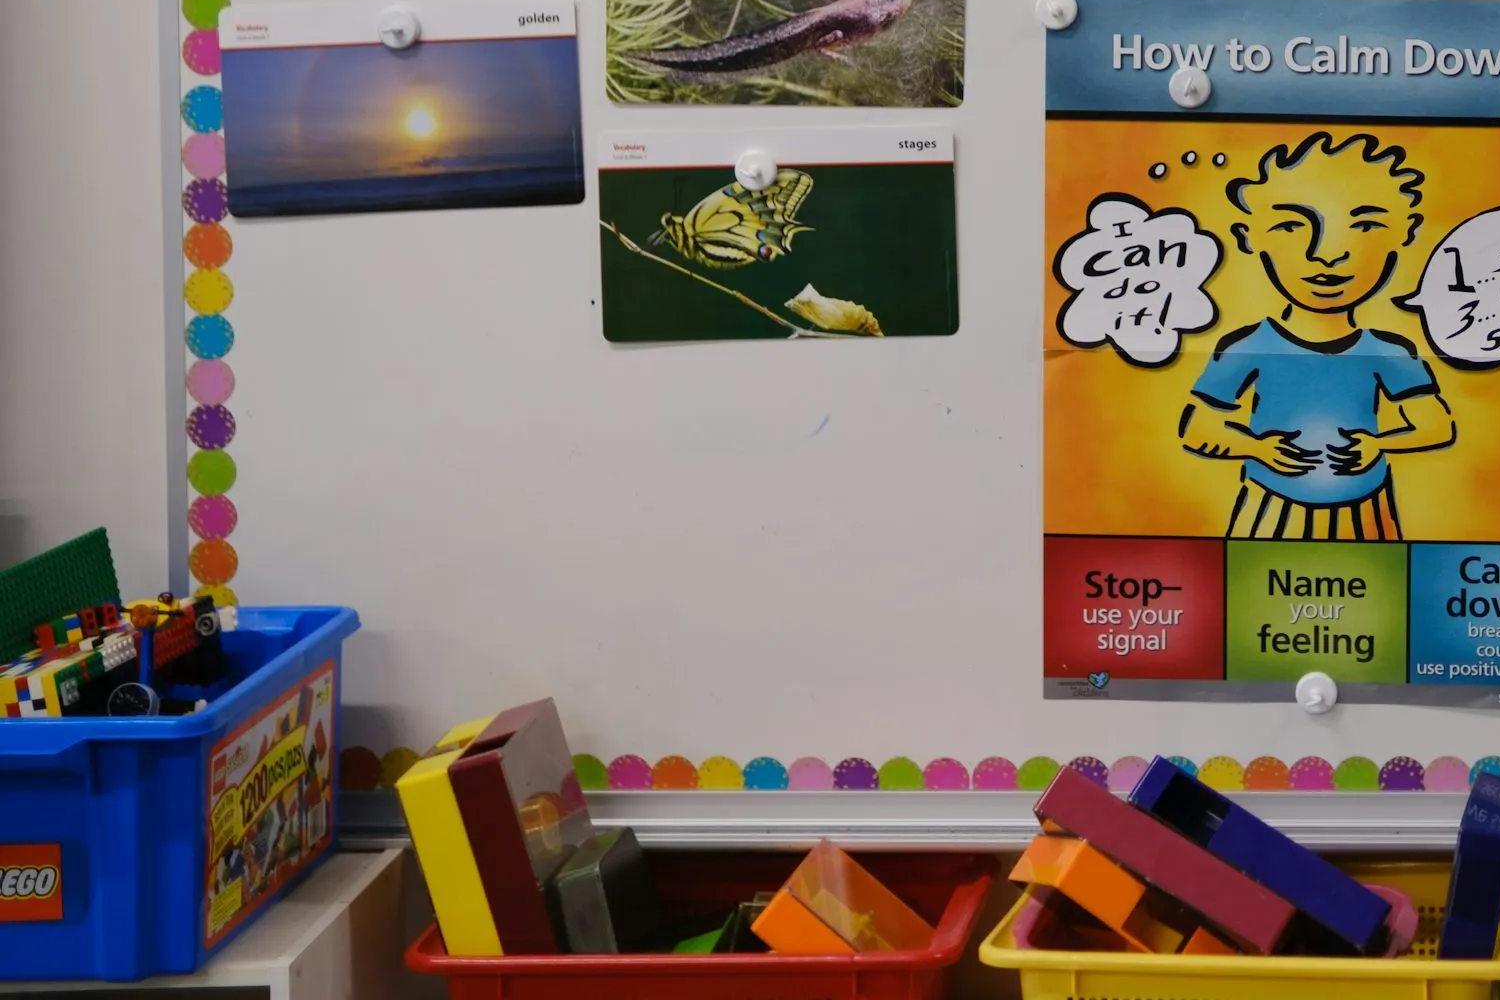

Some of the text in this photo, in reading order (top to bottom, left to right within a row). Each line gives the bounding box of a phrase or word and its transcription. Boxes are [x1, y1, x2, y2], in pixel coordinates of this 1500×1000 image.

[518, 12, 560, 25] golden
[1111, 33, 1215, 74] How
[1225, 38, 1273, 74] to
[1284, 34, 1390, 75] Calm
[898, 138, 937, 151] stages
[1112, 220, 1133, 239] I
[1083, 239, 1187, 277] can
[1103, 277, 1160, 299] do
[1114, 292, 1172, 335] it!
[1267, 568, 1368, 599] Name
[1082, 607, 1184, 631] use your
[1288, 600, 1345, 624] your
[1097, 629, 1168, 655] signal
[1256, 624, 1376, 663] feeling
[1416, 663, 1445, 676] use
[0, 867, 57, 896] EGO
